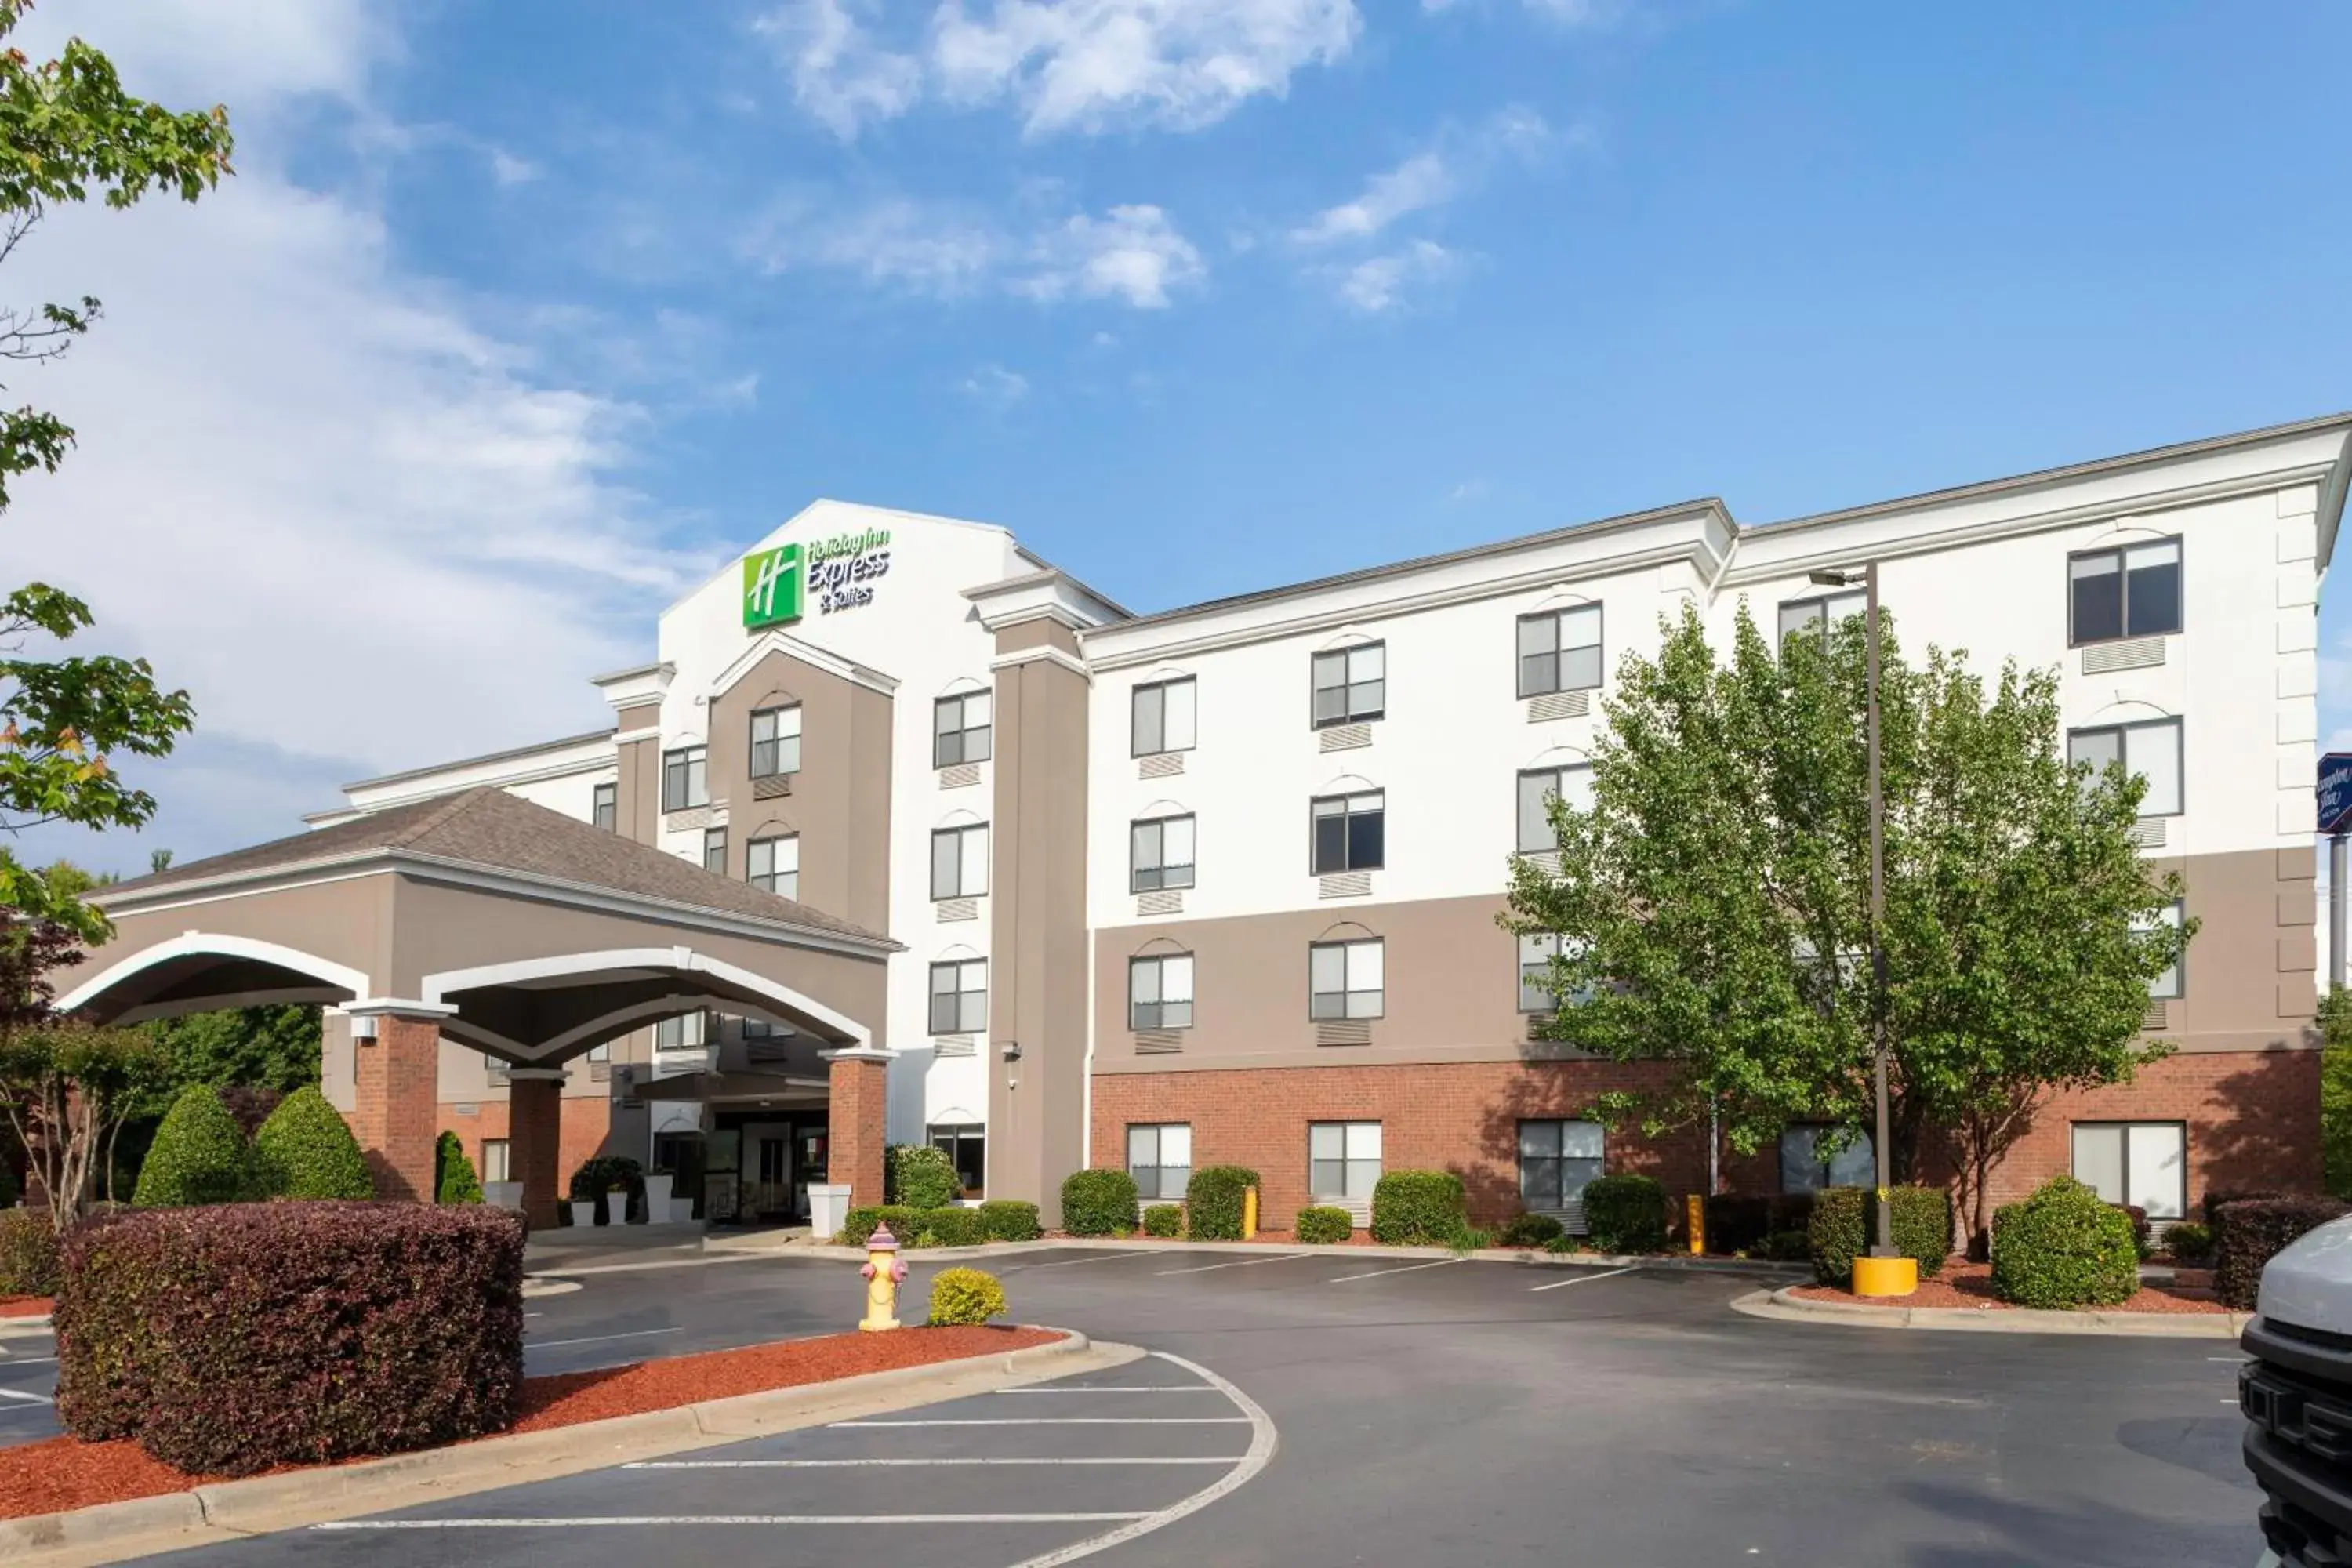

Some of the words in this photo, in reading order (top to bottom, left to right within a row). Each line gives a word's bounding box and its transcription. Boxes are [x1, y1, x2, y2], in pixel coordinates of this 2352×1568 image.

[808, 535, 864, 562] Holiday
[863, 527, 891, 550] Inn
[808, 551, 891, 593] Express
[820, 592, 832, 615] &
[831, 587, 875, 612] Suites
[2318, 768, 2352, 792] ampton
